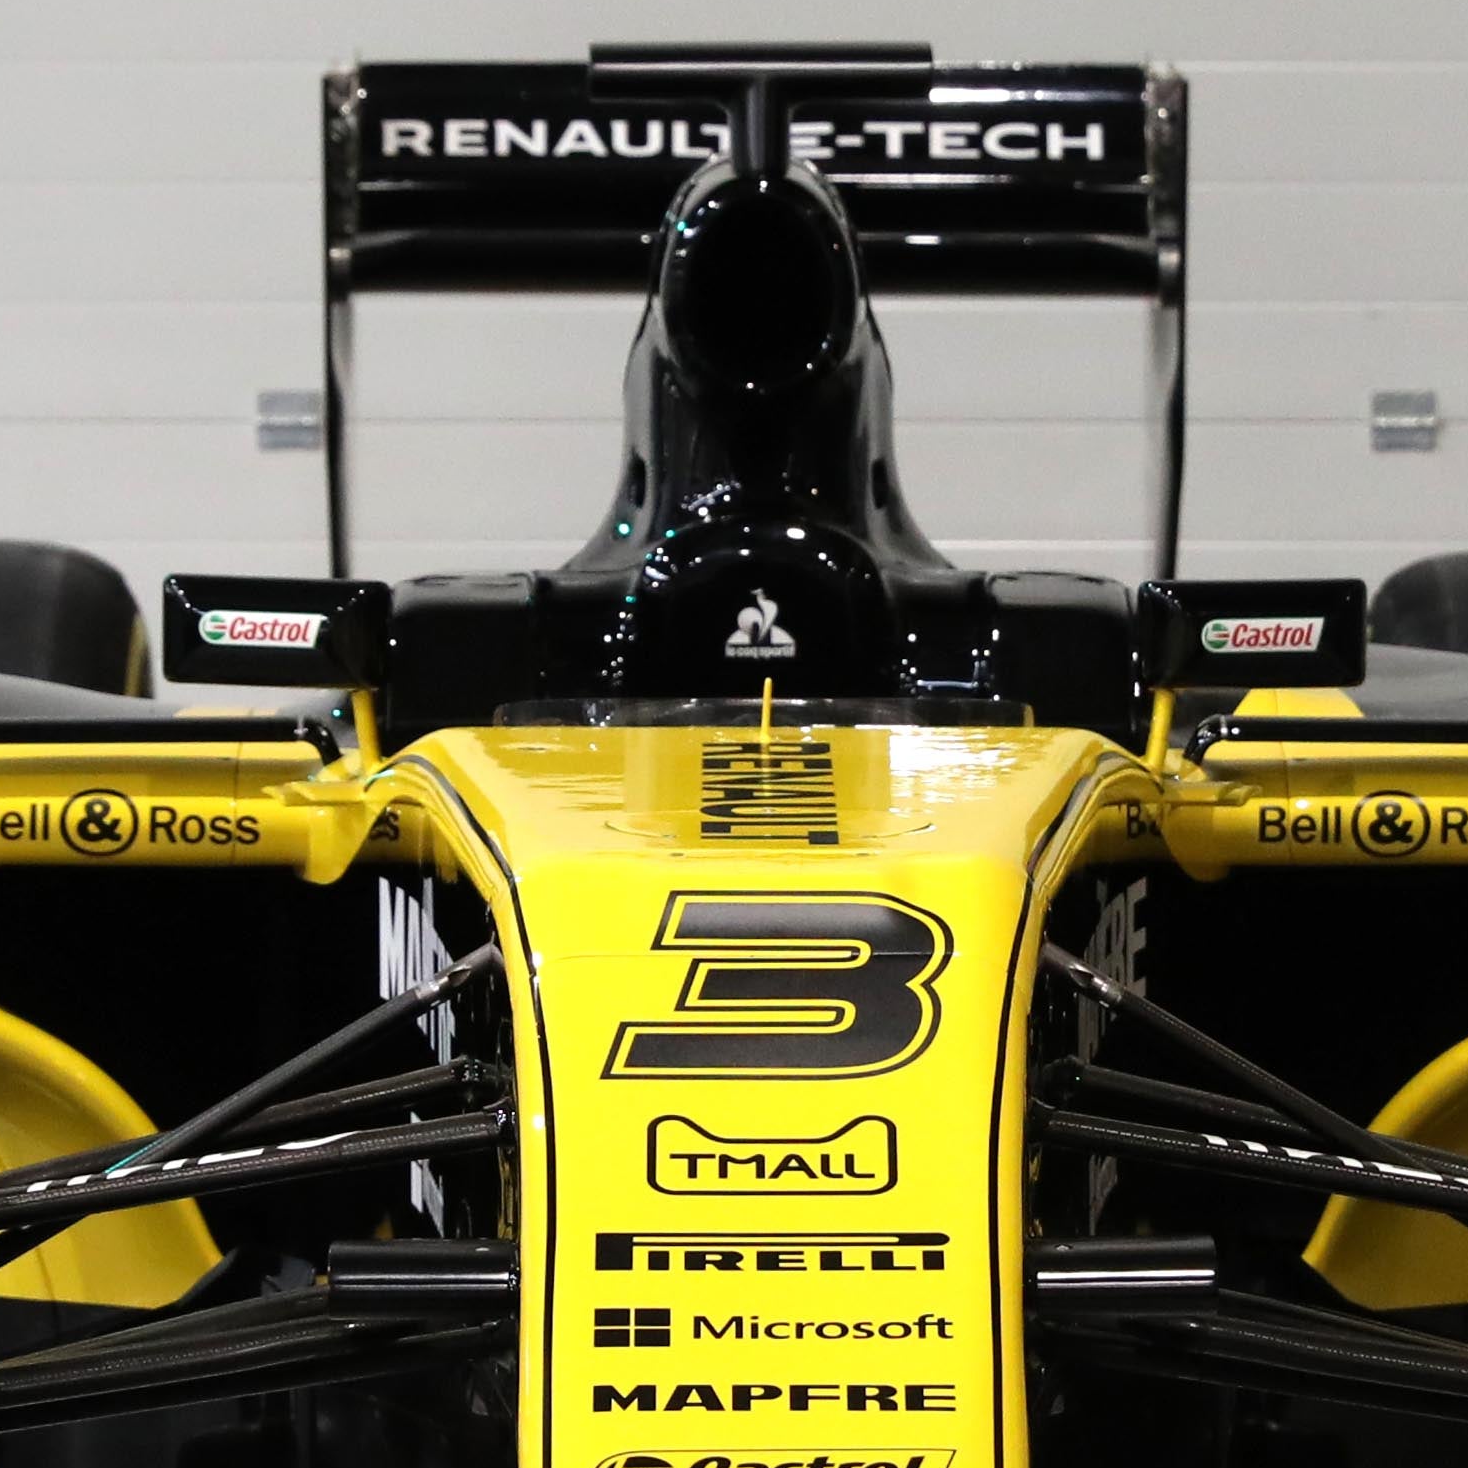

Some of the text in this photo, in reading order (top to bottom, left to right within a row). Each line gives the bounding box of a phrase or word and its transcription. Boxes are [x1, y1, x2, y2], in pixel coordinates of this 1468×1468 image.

[788, 121, 1103, 160] E-TECH
[230, 616, 311, 643] Castrol
[1231, 622, 1314, 648] Castrol
[700, 742, 840, 845] RENAULT
[149, 806, 261, 846] Ross
[1258, 806, 1342, 844] Bell
[600, 890, 954, 1080] 3
[669, 1153, 876, 1179] TMALL
[595, 1232, 951, 1271] PIRELLI
[692, 1313, 954, 1340] Microsoft
[592, 1384, 957, 1412] MAPFRE
